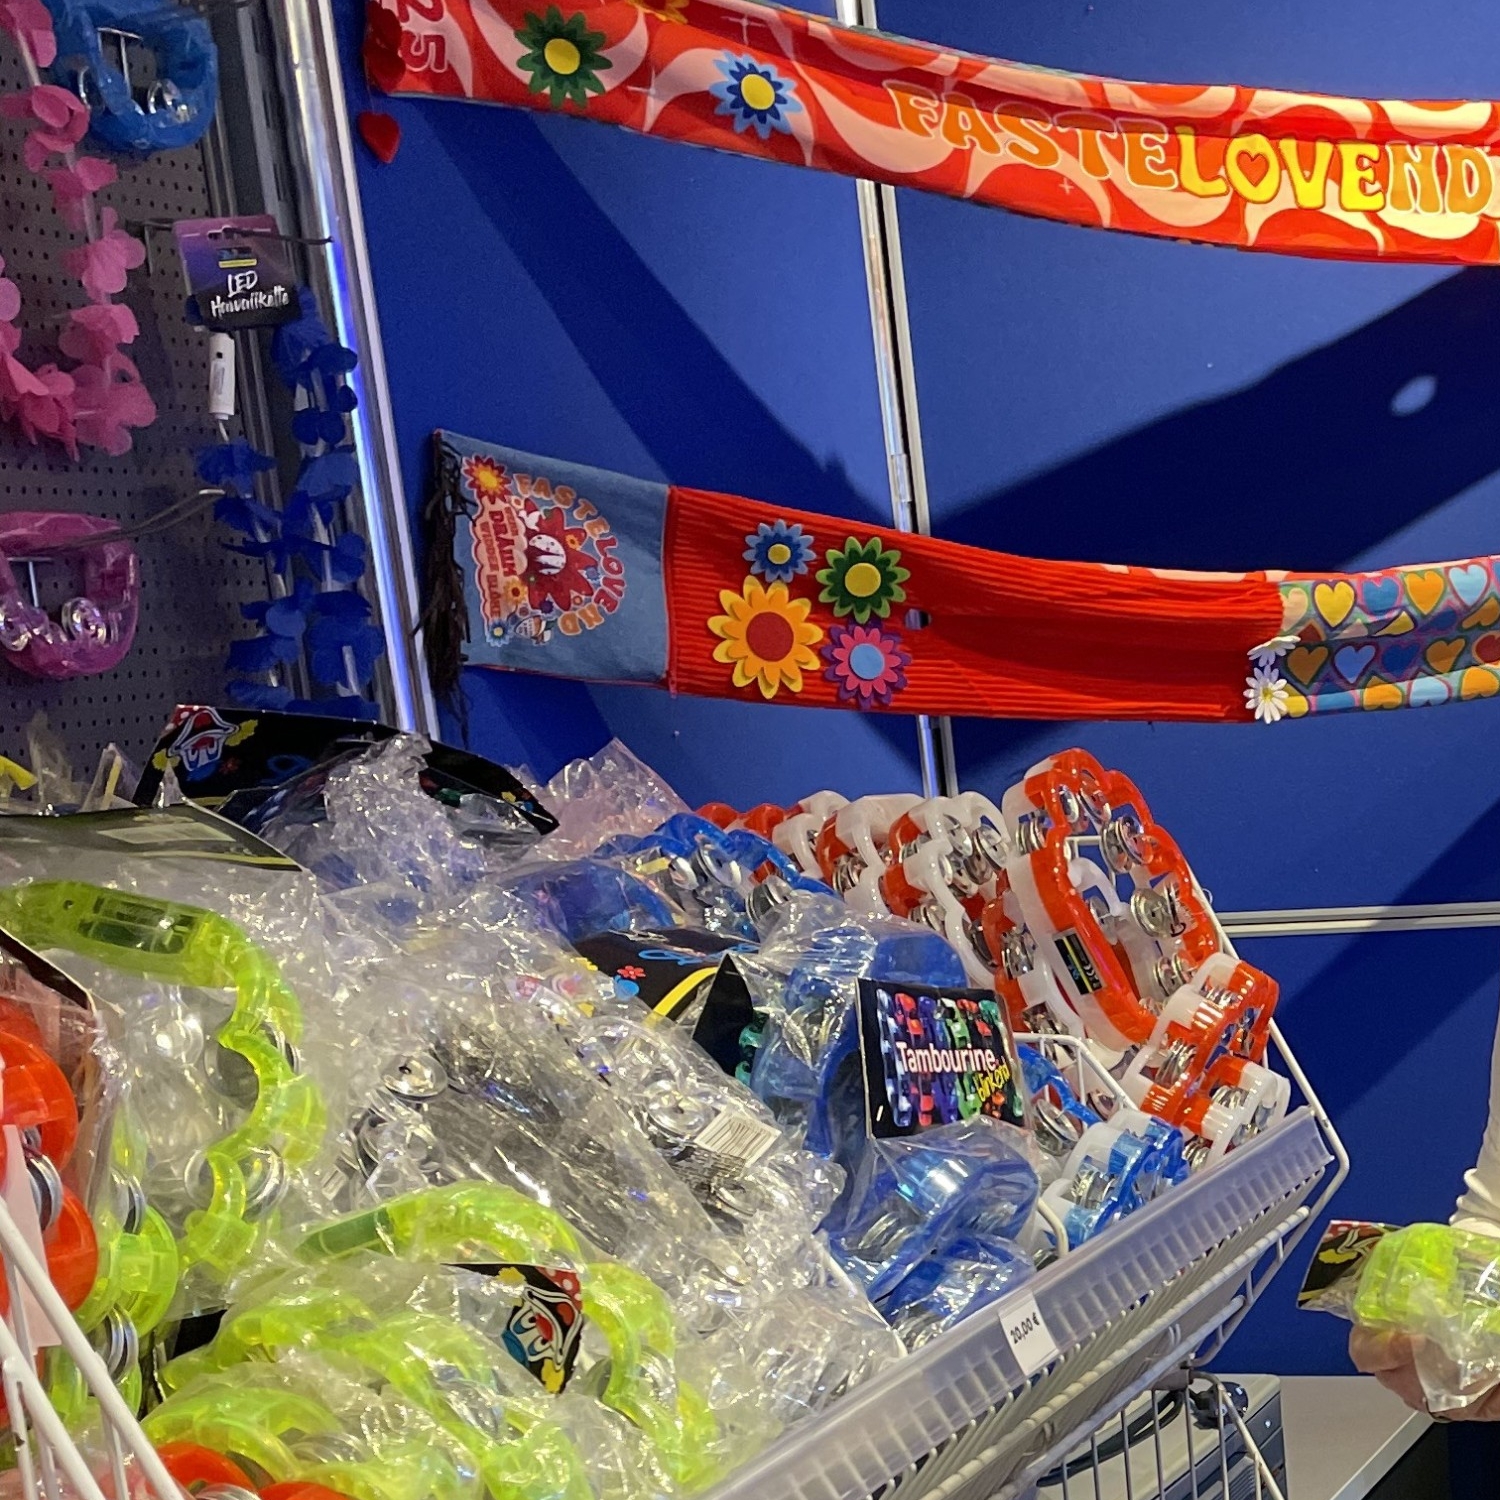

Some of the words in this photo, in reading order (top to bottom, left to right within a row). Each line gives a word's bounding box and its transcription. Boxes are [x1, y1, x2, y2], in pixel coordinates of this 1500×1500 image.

[883, 79, 1494, 217] FASTELOVEND
[227, 270, 259, 298] LED
[210, 285, 290, 318] Hawaiikette
[513, 473, 627, 636] FASTELOVEND
[895, 1042, 996, 1073] Tambourine
[1010, 1317, 1034, 1345] 20,00
[1032, 1312, 1040, 1326] €
